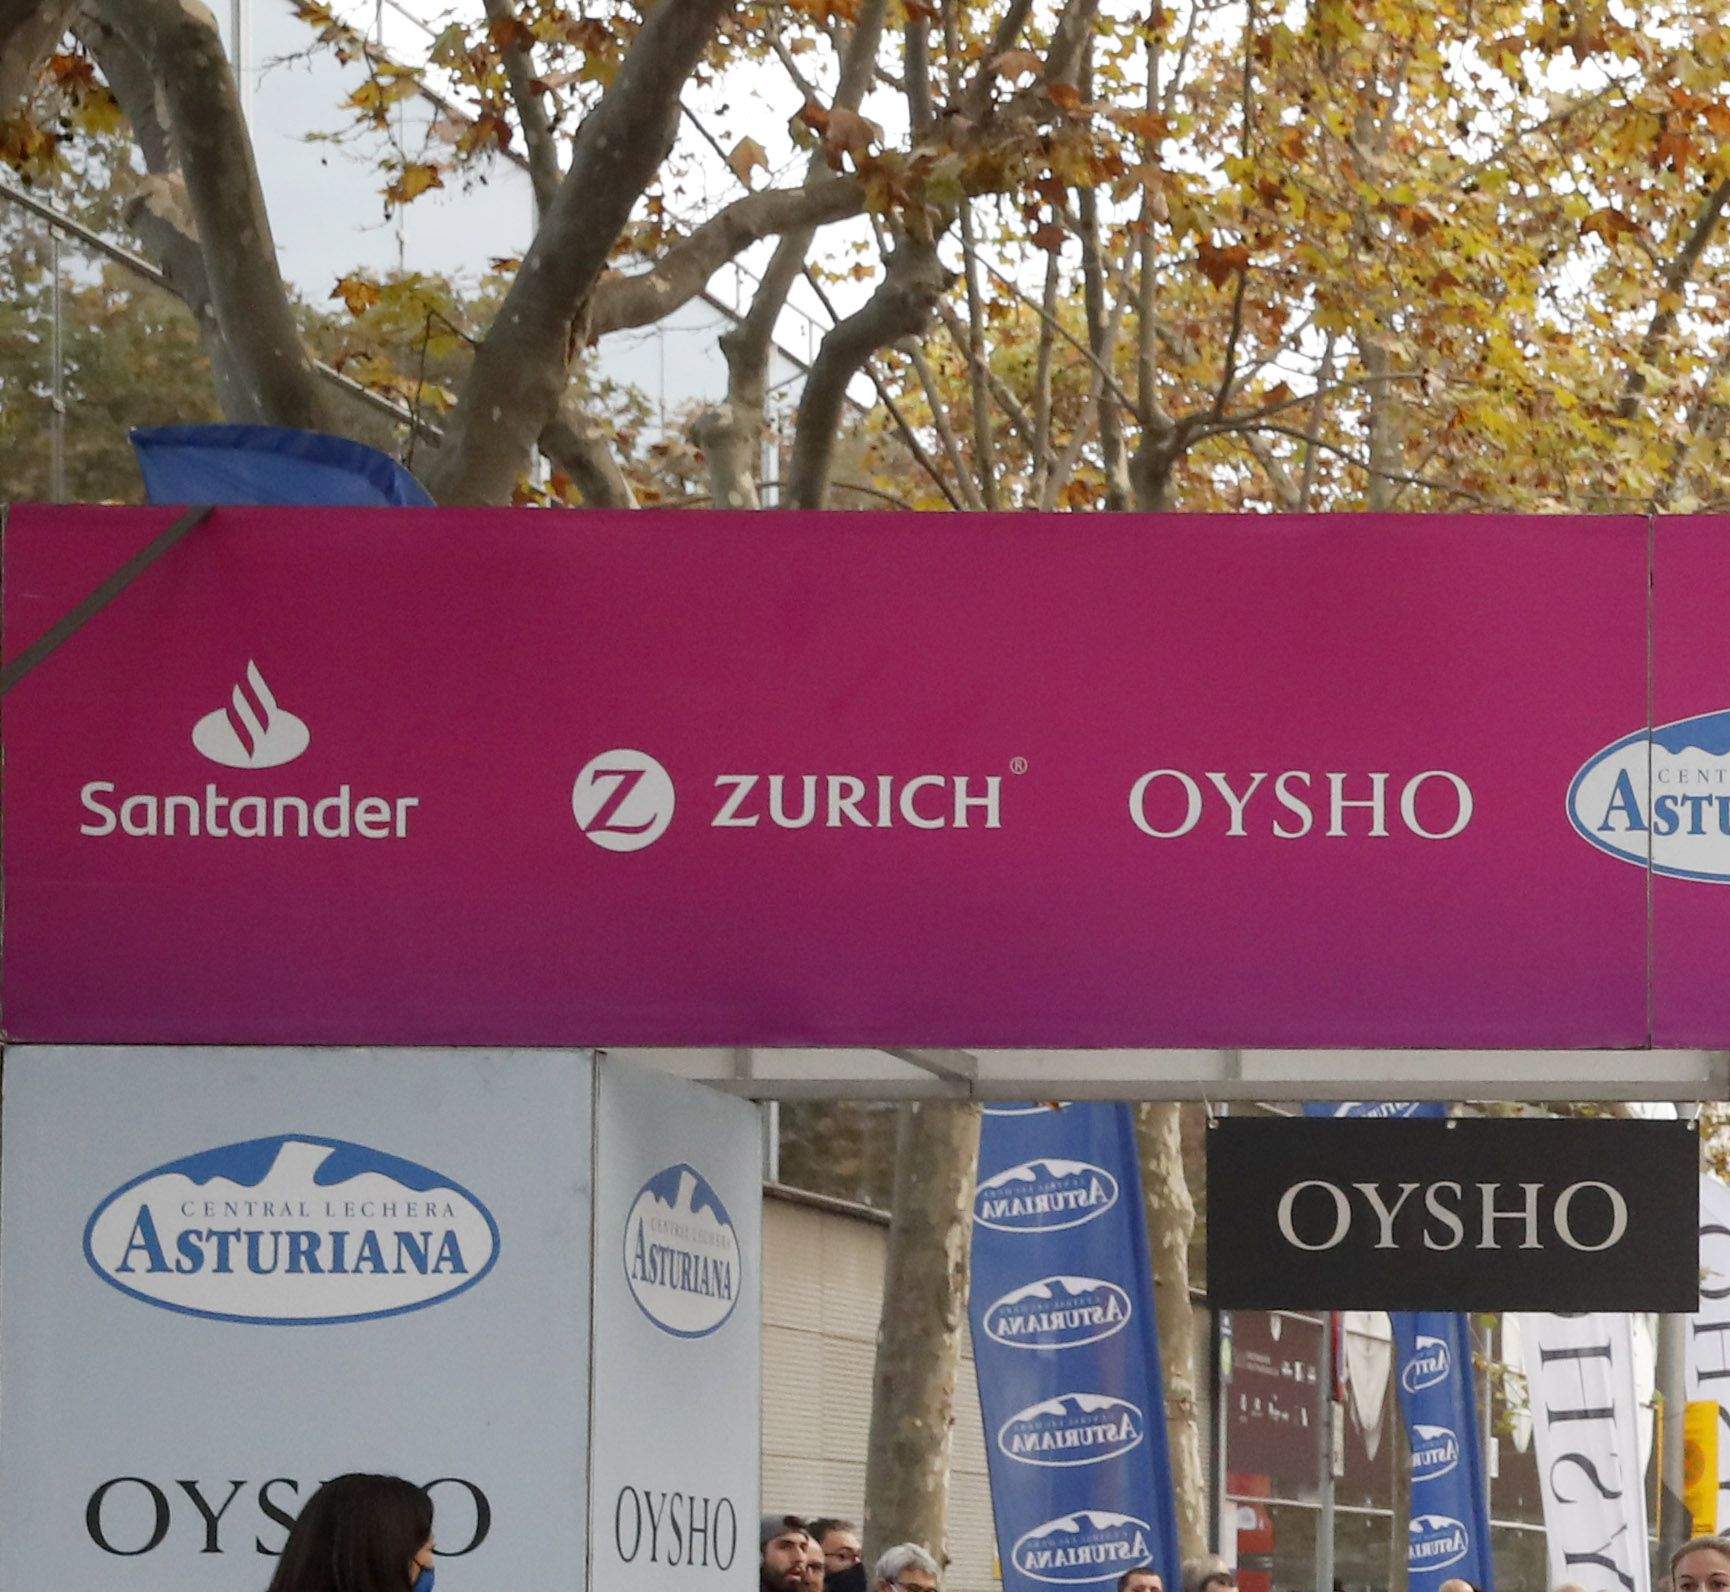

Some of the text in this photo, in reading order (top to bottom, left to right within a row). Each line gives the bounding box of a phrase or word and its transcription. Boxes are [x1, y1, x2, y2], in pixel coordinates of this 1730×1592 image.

[80, 781, 420, 840] Santander
[711, 774, 1003, 828] ZURICH
[1128, 769, 1474, 840] OYSHO
[115, 1204, 470, 1276] ASTURIANA
[181, 1202, 456, 1218] CENTRAL LECHERA
[1277, 1180, 1628, 1251] OYSHO
[631, 1216, 732, 1301] ASTURIANA
[85, 1477, 492, 1557] OYSO
[615, 1485, 737, 1572] OYSHO
